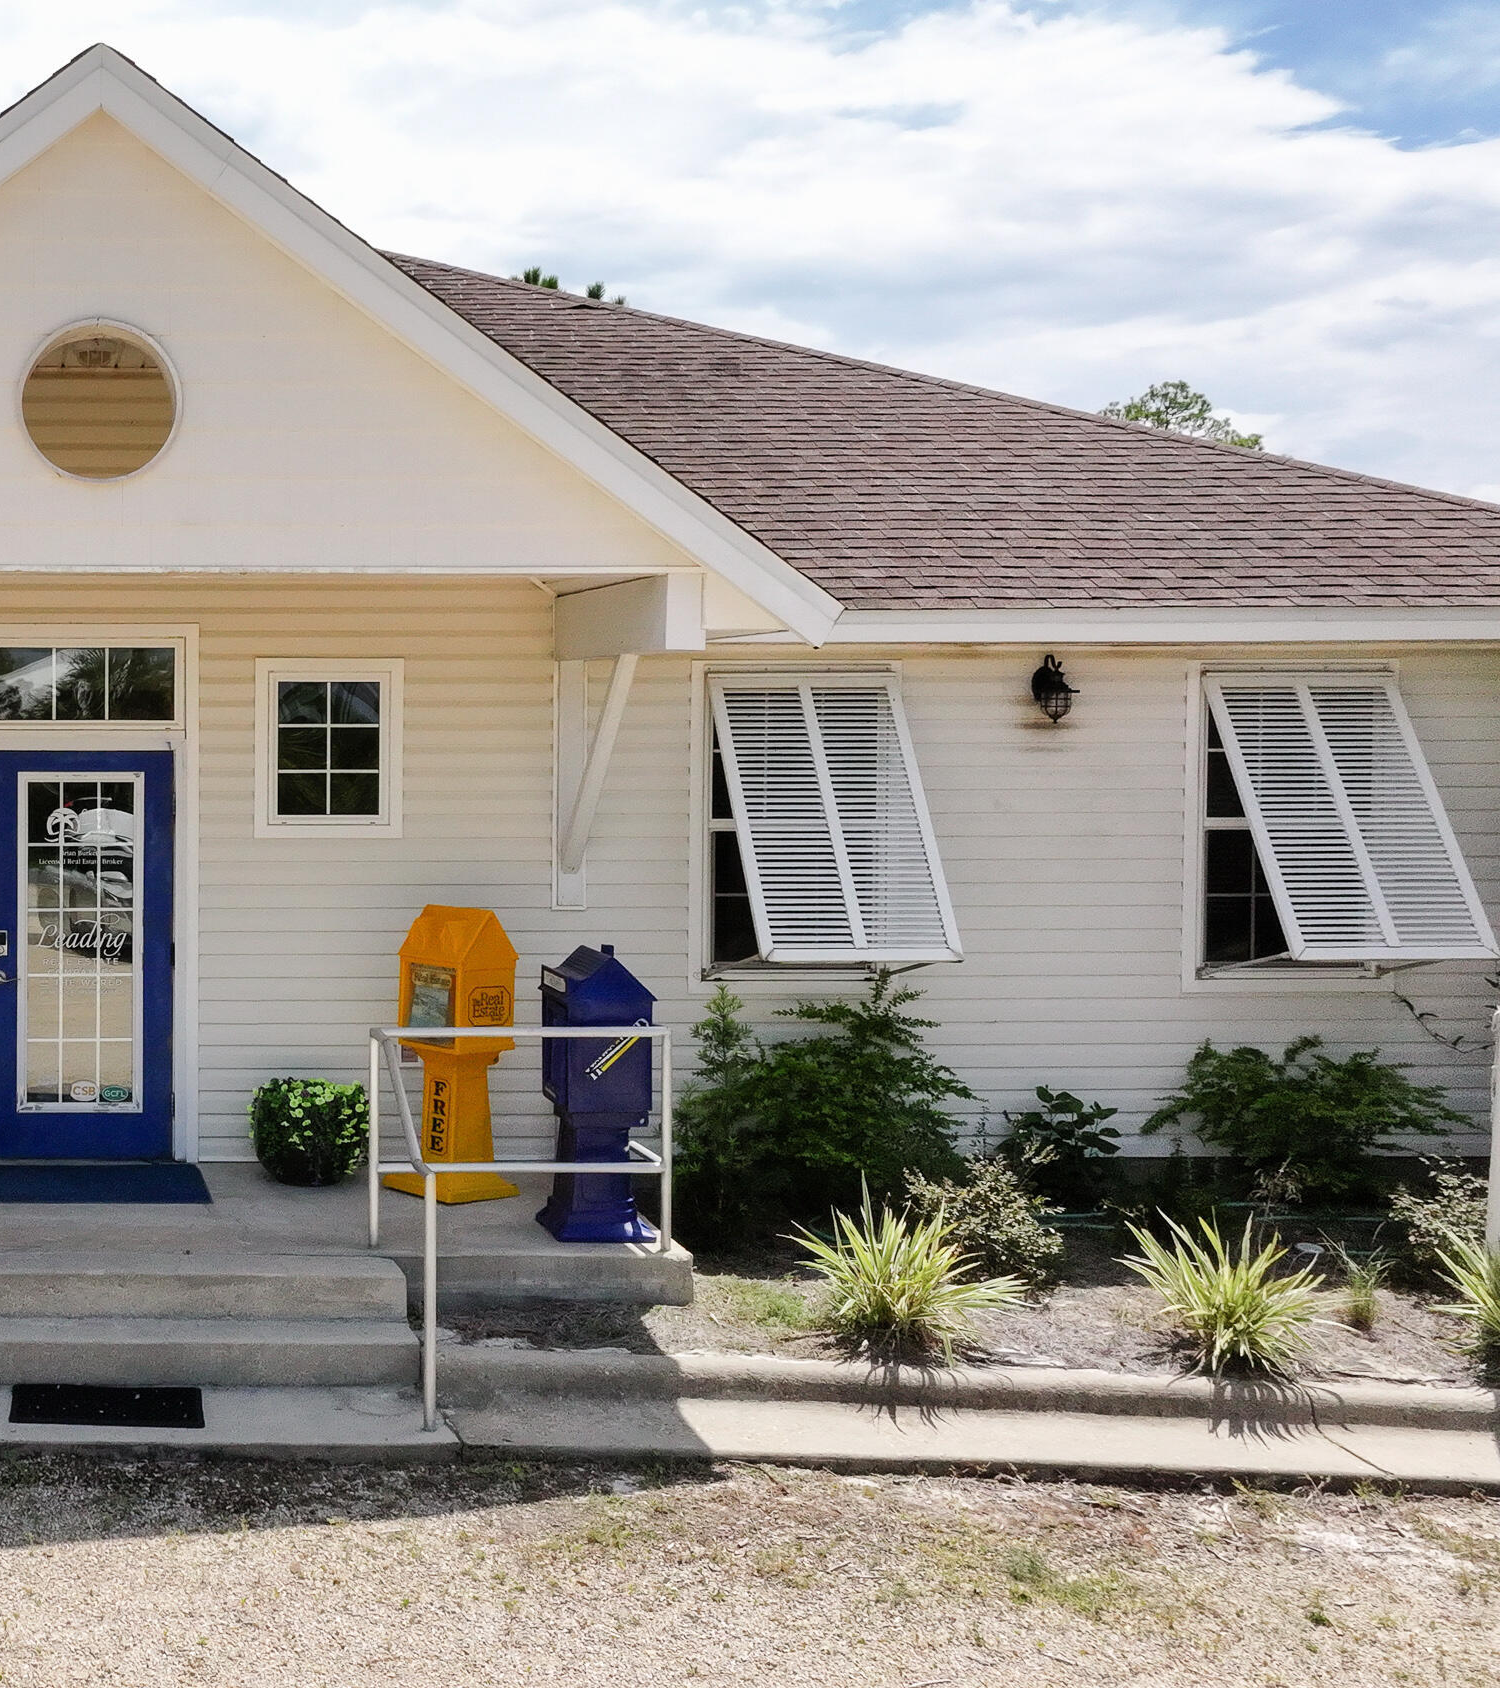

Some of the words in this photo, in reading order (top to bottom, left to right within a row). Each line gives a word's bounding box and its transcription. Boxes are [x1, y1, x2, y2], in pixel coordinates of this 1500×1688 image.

[36, 913, 128, 957] Leading
[481, 990, 504, 1006] Real
[472, 1005, 505, 1018] Estate
[73, 1086, 96, 1096] CSB
[430, 1080, 447, 1153] FREE
